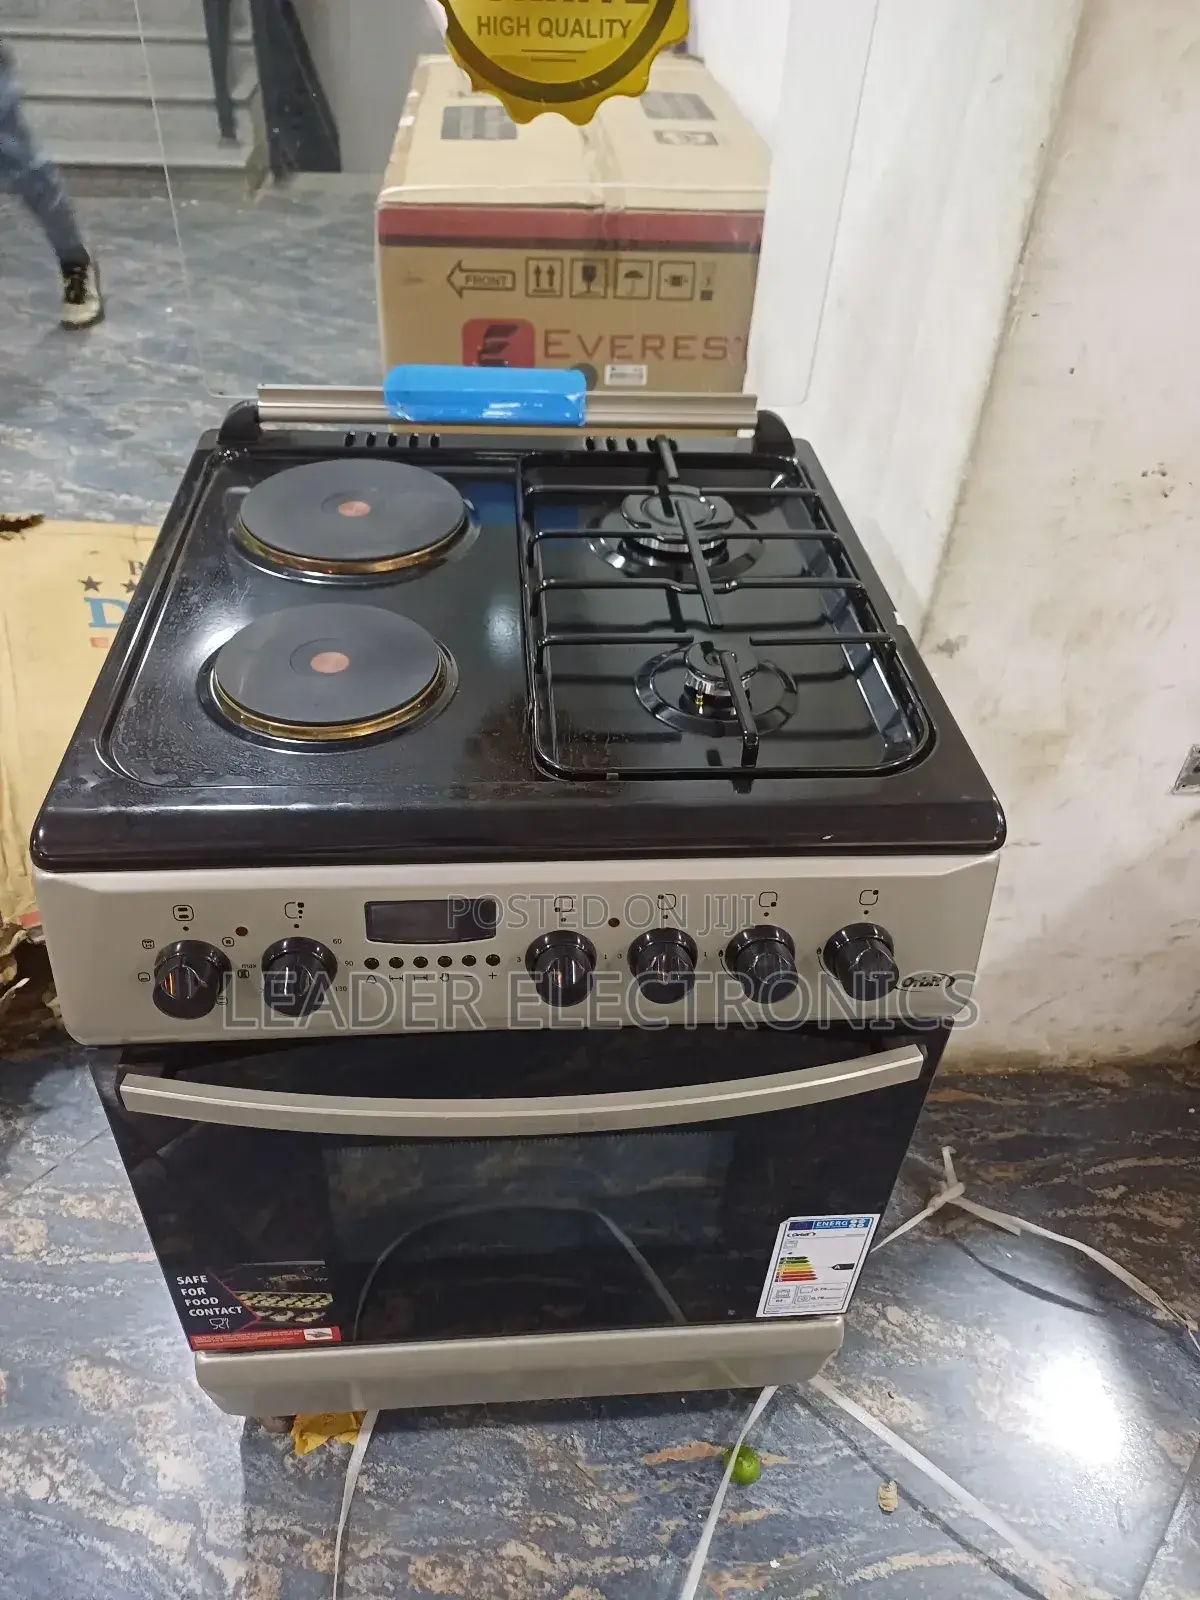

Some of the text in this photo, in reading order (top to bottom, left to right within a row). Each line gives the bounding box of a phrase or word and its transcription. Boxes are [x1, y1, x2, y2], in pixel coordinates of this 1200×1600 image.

[477, 15, 633, 40] HIGH QUALITY
[464, 275, 508, 287] FRONT
[543, 328, 747, 362] EVERES
[344, 959, 354, 967] 90
[176, 1274, 208, 1286] SAFE
[180, 1286, 207, 1297] FOR
[184, 1296, 219, 1307] FOOD
[188, 1306, 243, 1318] CONTACT
